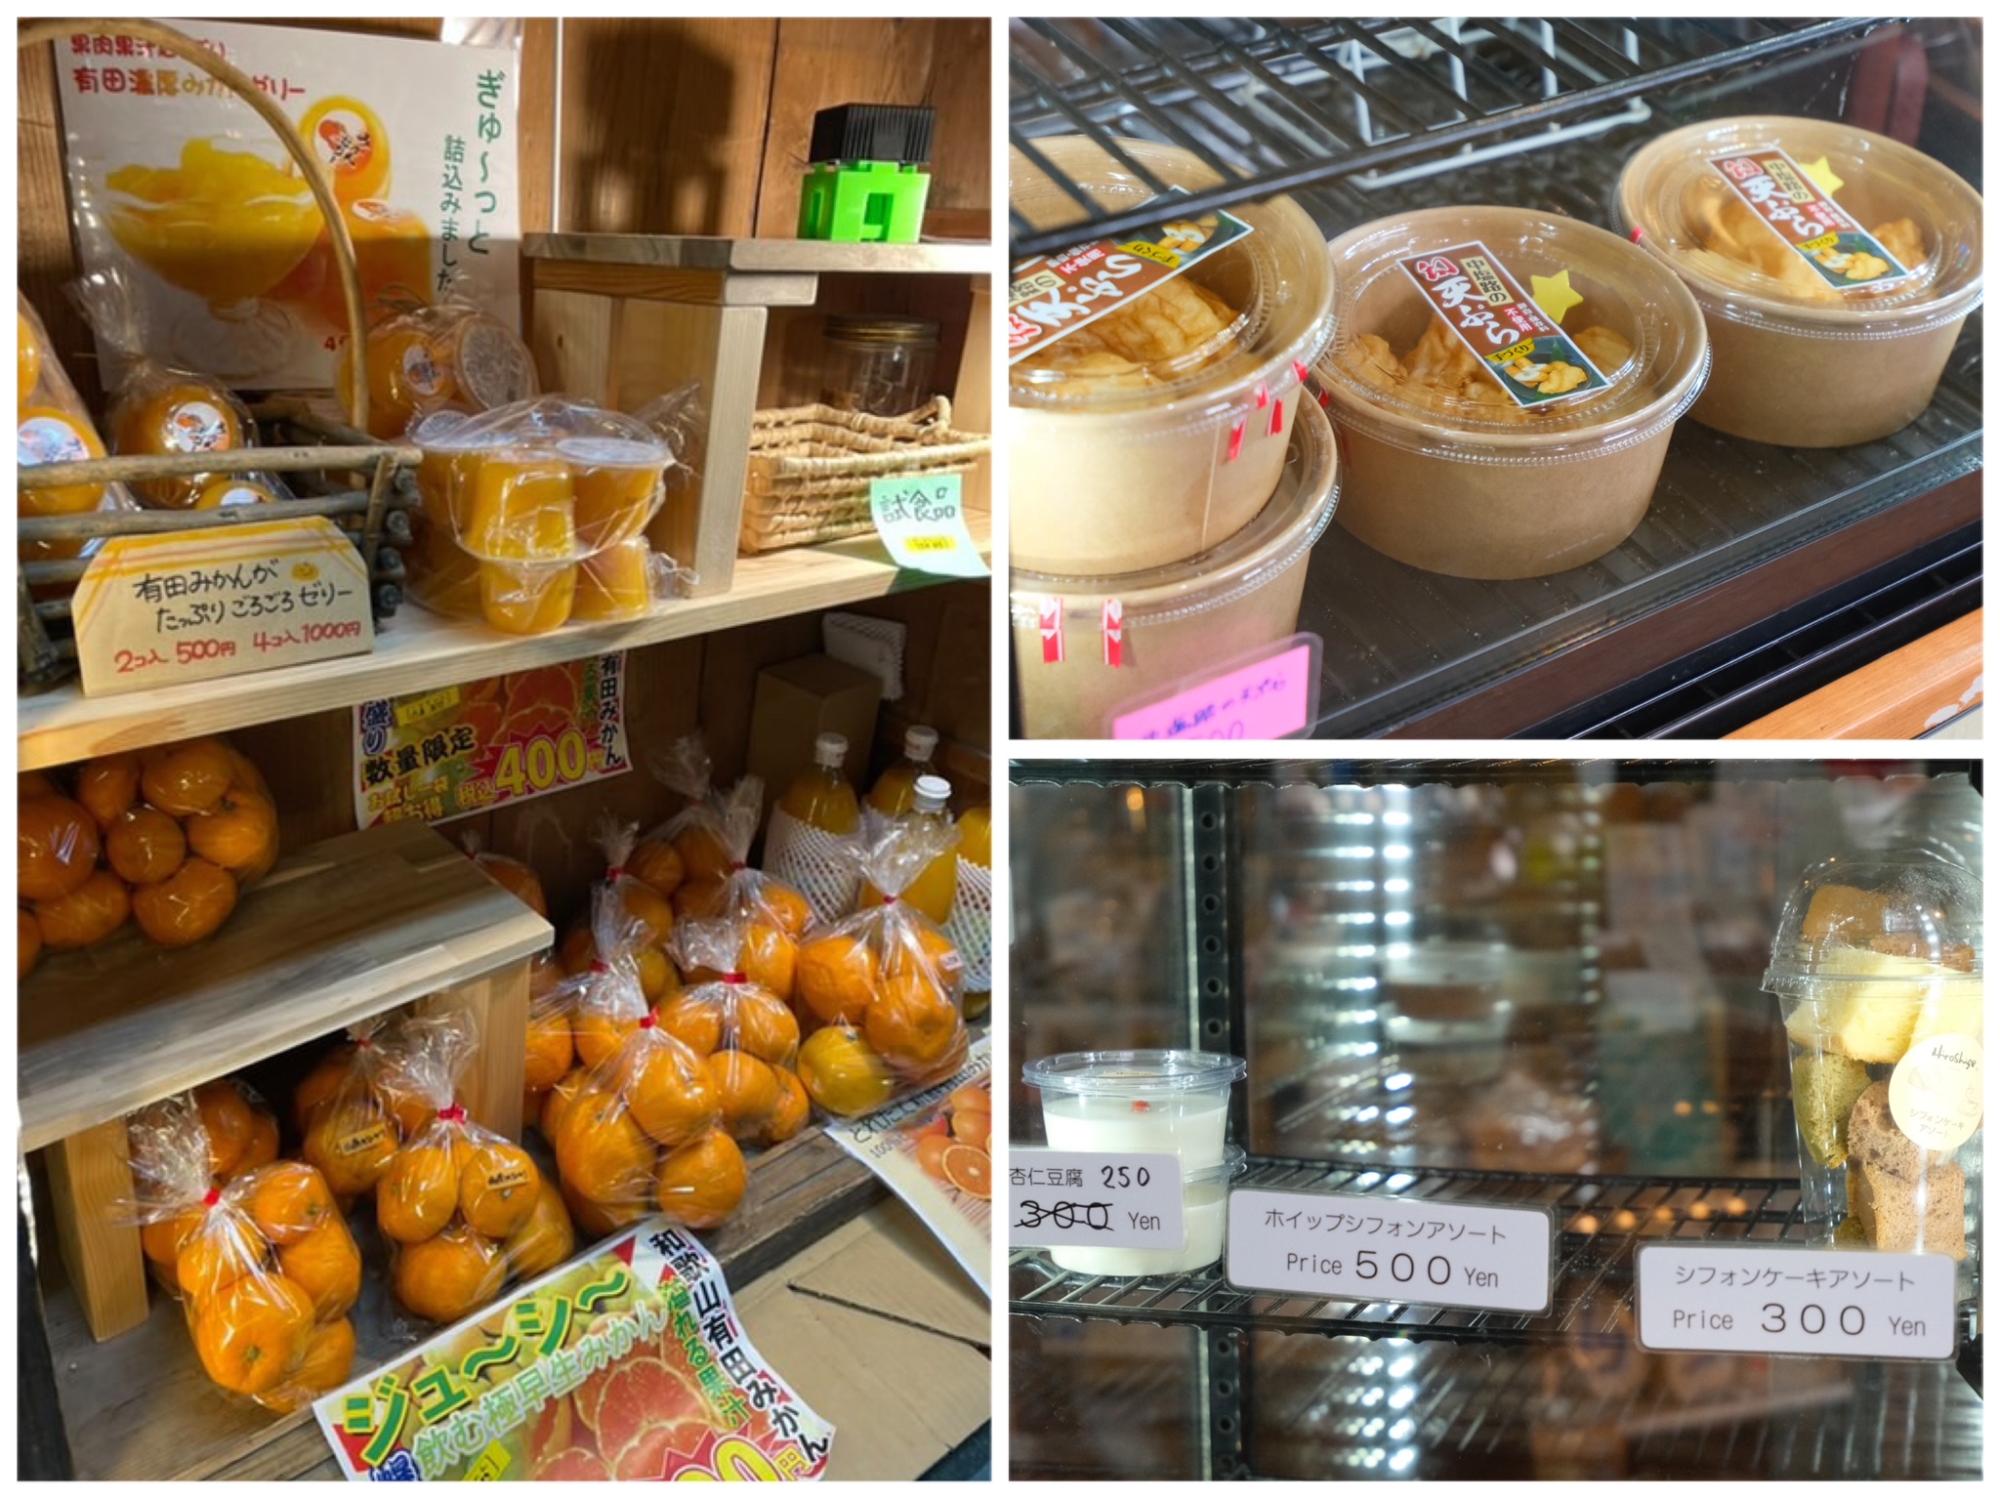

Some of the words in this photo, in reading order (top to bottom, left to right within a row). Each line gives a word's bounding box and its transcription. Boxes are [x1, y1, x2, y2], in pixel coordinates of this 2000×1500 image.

[437, 134, 466, 293] 詰込みました
[880, 485, 956, 523] 試食品
[132, 558, 280, 604] 有田みかんが
[176, 638, 237, 664] 500円
[365, 726, 476, 786] 数量限定
[1009, 1167, 1083, 1188] 杏仁豆腐
[1101, 1165, 1150, 1189] 250
[1128, 1211, 1161, 1231] Yen
[1265, 1208, 1506, 1245] ホイップシフォンアソート
[1287, 1253, 1343, 1276] Price
[1355, 1250, 1452, 1286] 500
[1464, 1267, 1499, 1288] Yen
[1675, 1264, 1915, 1292] シフォンケーキアソート
[1673, 1309, 1734, 1330] Price
[1761, 1303, 1866, 1336] 300
[1889, 1315, 1927, 1337] Yen
[650, 1228, 830, 1463] 和歌山有田みかん
[413, 1301, 669, 1480] 飲む極早生みかん
